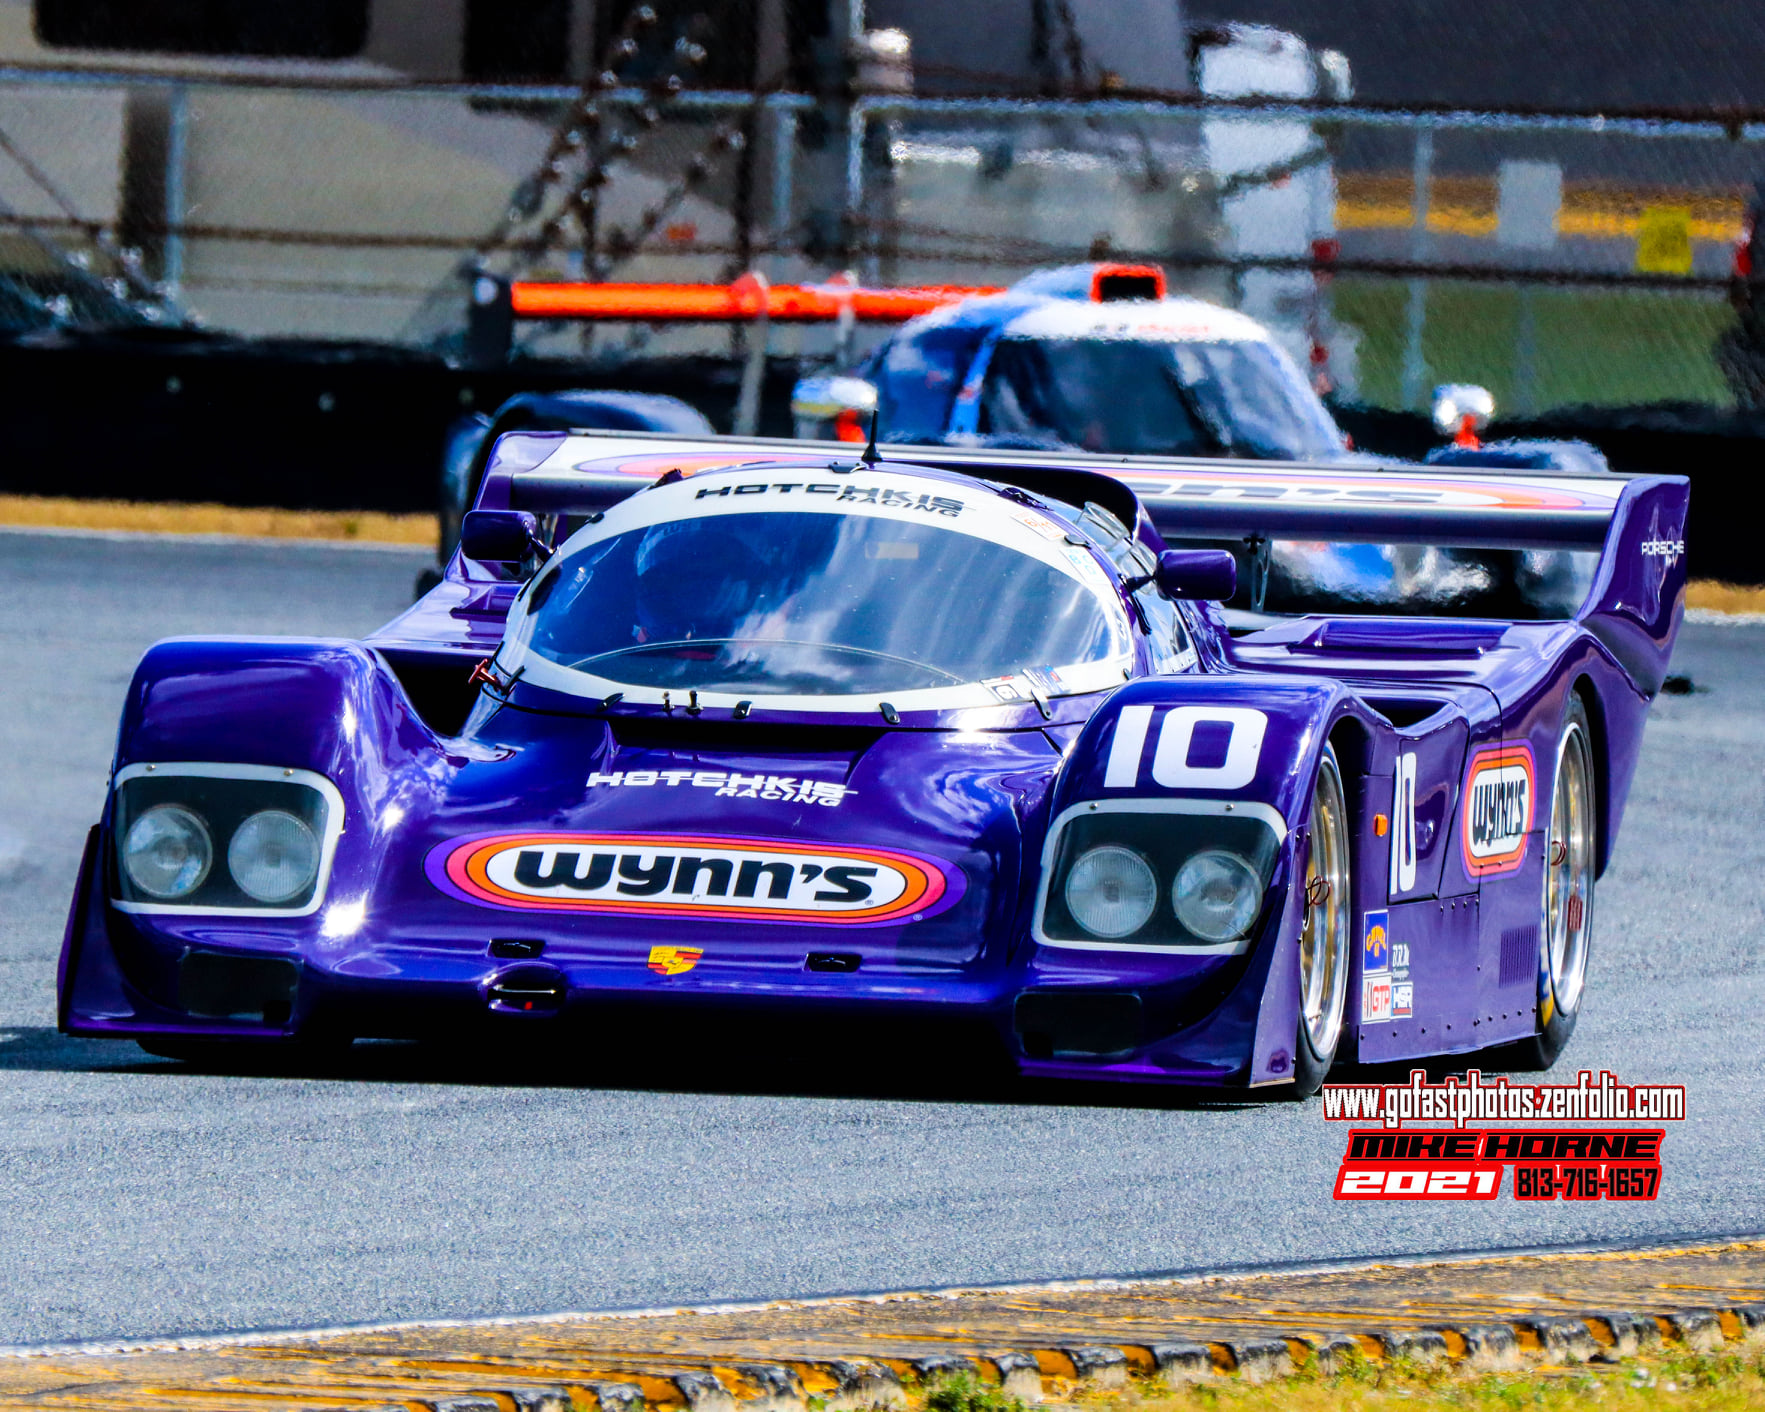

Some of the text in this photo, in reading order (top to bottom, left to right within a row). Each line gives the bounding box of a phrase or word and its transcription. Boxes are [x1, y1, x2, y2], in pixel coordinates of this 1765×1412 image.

[695, 483, 965, 512] HOTCHKIS
[837, 494, 960, 518] RACING
[1641, 540, 1685, 556] PORSCHE
[1103, 704, 1269, 790] 10
[586, 771, 852, 799] HOTCHKIS
[714, 786, 842, 807] RACING
[1389, 751, 1417, 895] 10
